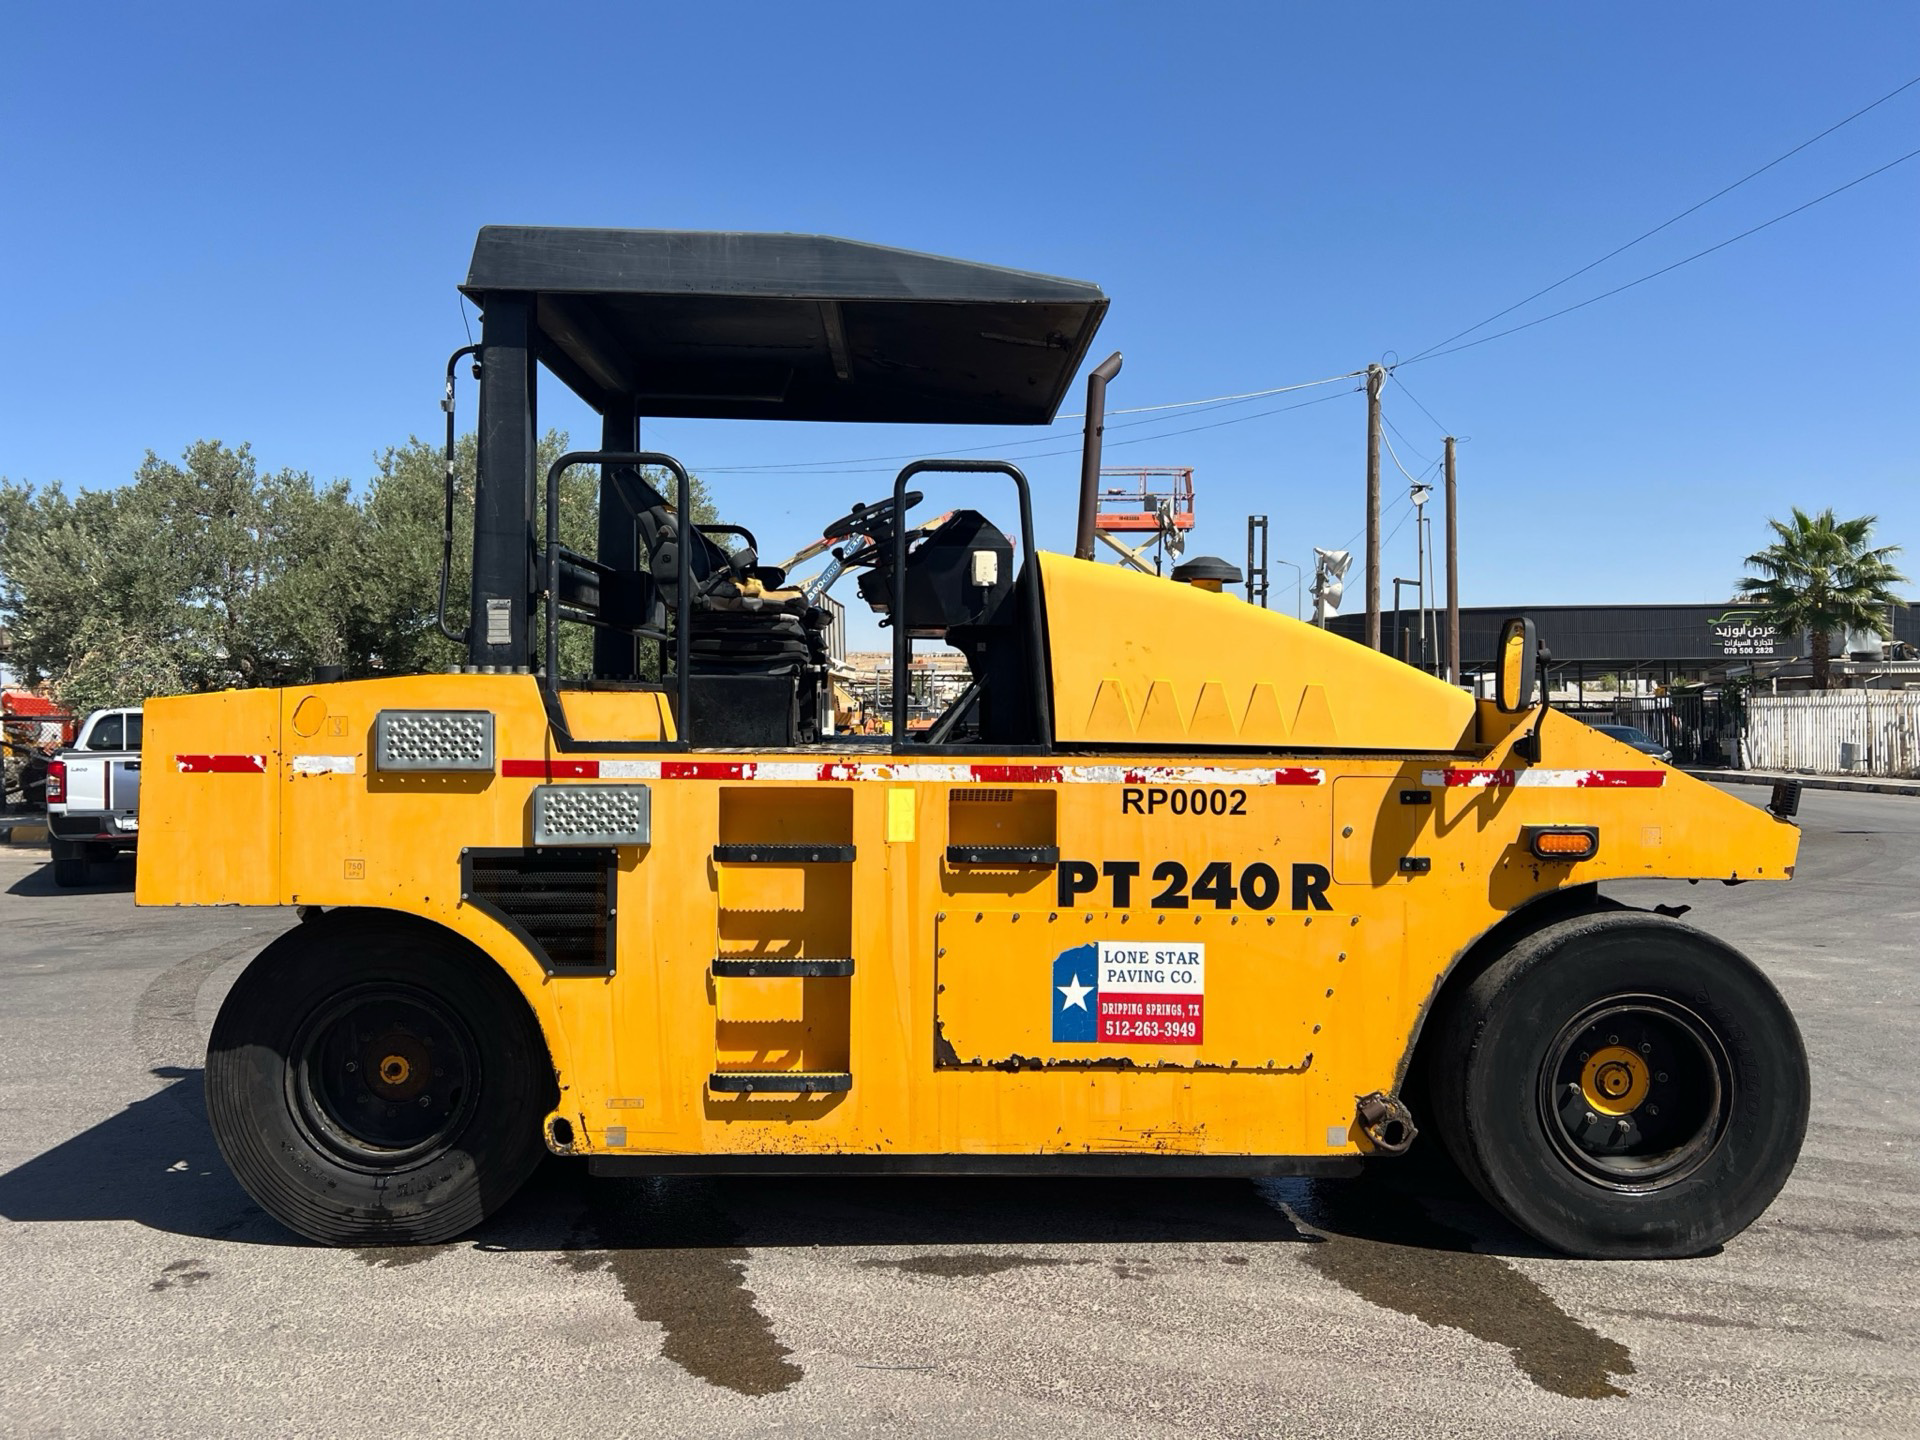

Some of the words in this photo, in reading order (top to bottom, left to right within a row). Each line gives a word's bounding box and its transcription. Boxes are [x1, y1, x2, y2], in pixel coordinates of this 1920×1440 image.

[1747, 625, 1780, 638] عرض
[1724, 638, 1751, 648] السيارات
[1724, 647, 1738, 655] 079
[1755, 646, 1774, 654] 2828
[1122, 788, 1247, 815] RP0002
[1057, 861, 1140, 908] PT
[1104, 950, 1149, 964] LONE
[1155, 951, 1200, 965] STAR
[1107, 969, 1165, 983] PAVING
[1170, 970, 1197, 984] CO.
[1102, 1002, 1143, 1015] DRIPPING
[1146, 1003, 1185, 1018] SPRINGS,
[1188, 1004, 1200, 1016] TX
[1105, 1021, 1196, 1037] 512-263-3949
